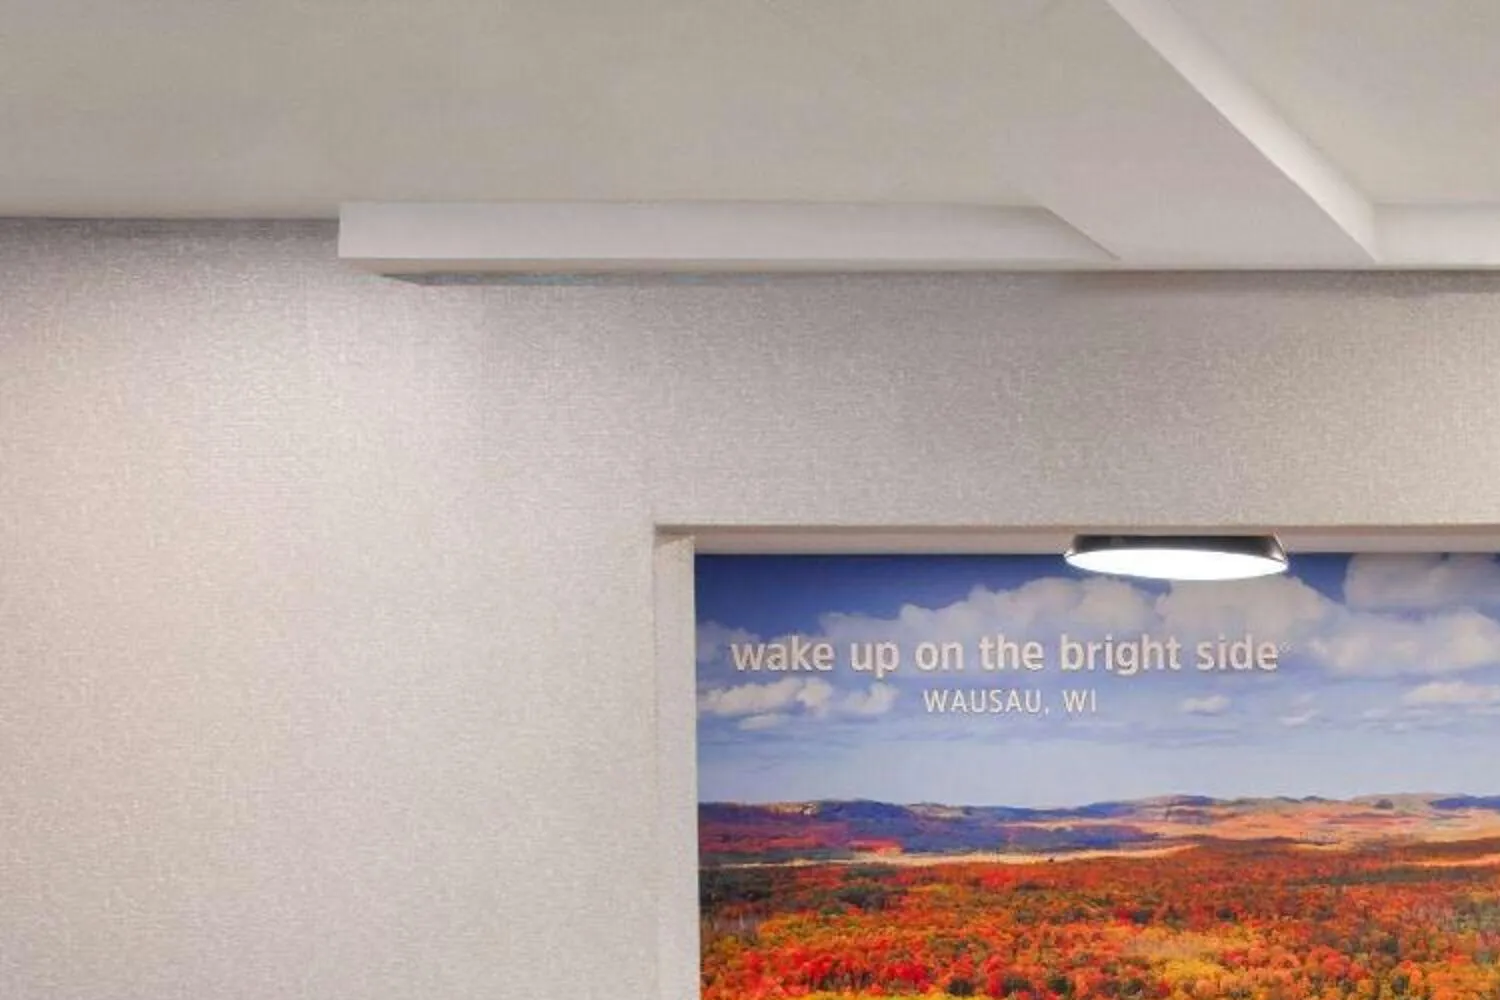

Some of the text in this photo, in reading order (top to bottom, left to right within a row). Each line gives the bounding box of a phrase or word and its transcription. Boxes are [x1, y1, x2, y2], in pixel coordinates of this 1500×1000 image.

[731, 633, 1280, 679] wake up on the bright side
[923, 690, 1097, 715] WAUSAU, WI
